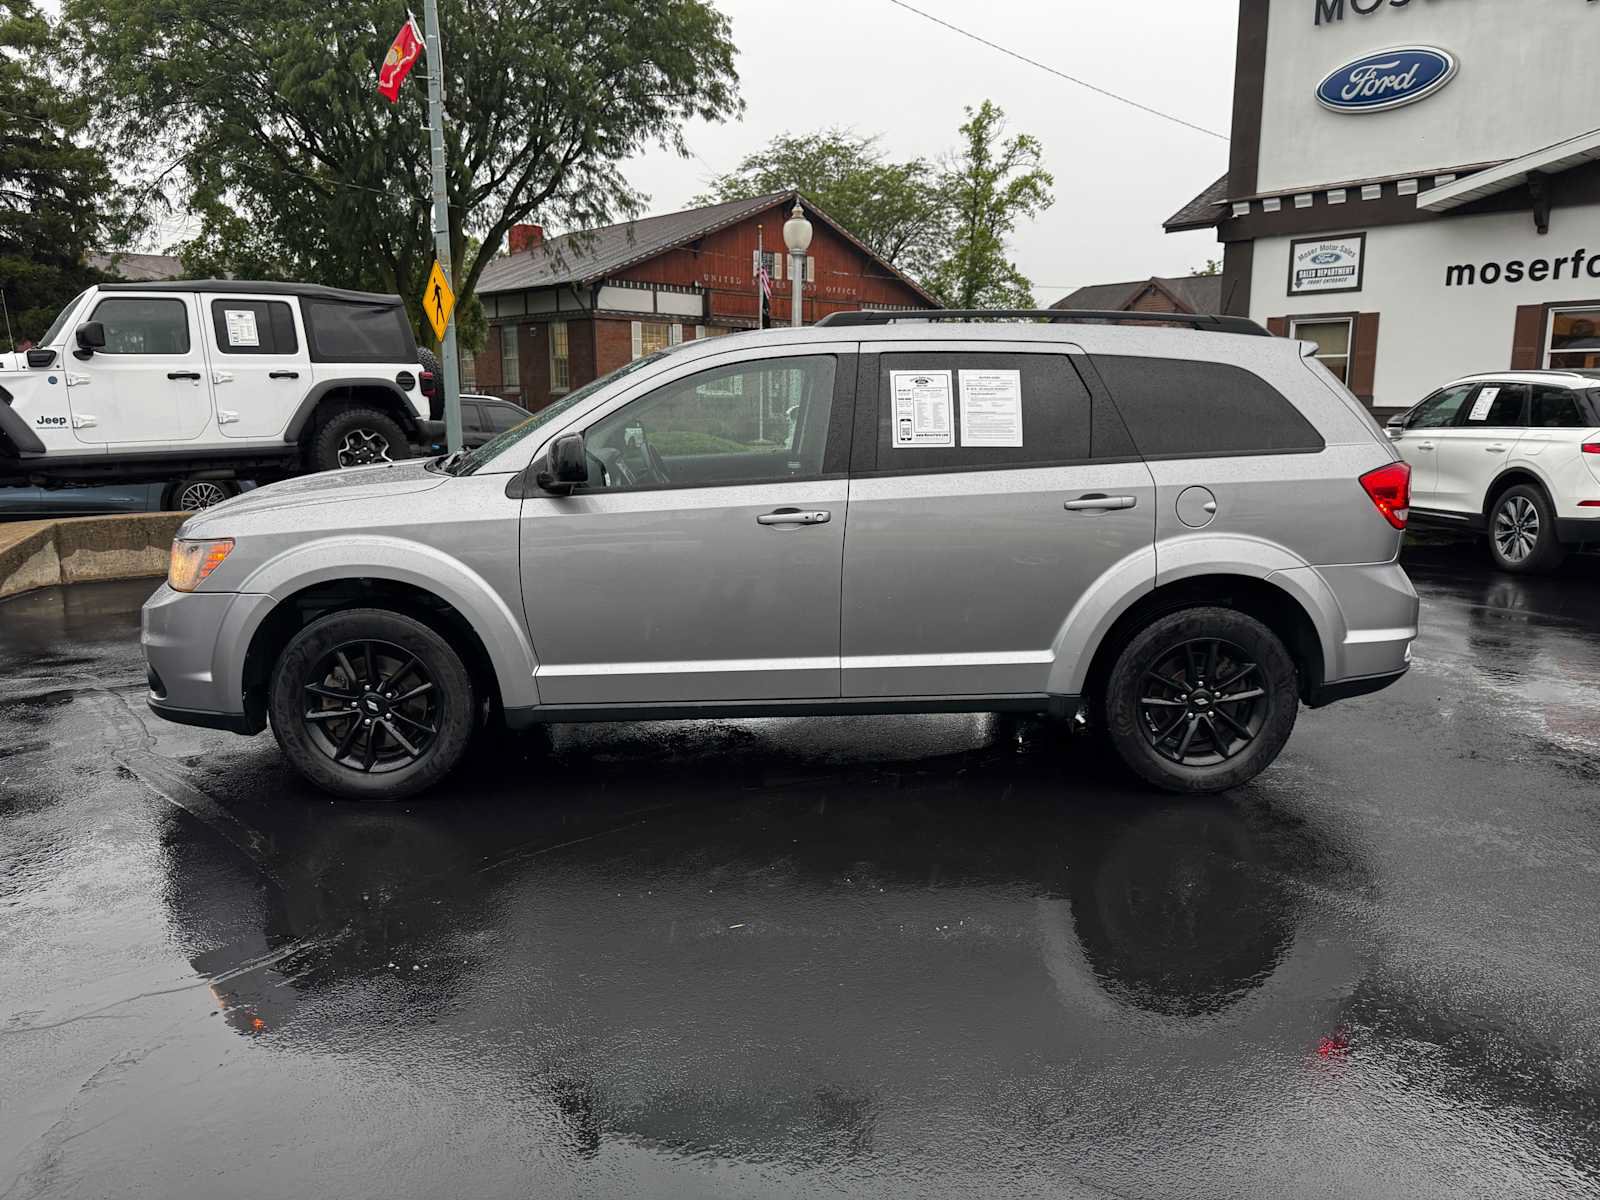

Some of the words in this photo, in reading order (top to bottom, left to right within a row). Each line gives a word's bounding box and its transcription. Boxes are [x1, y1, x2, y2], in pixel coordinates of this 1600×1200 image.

[1341, 60, 1420, 100] Ford
[1298, 247, 1318, 262] Moser
[1320, 243, 1339, 252] Motor
[1340, 245, 1356, 259] Sales
[703, 274, 742, 285] UNITED
[826, 286, 857, 296] OFFICE
[37, 415, 67, 426] Jeep
